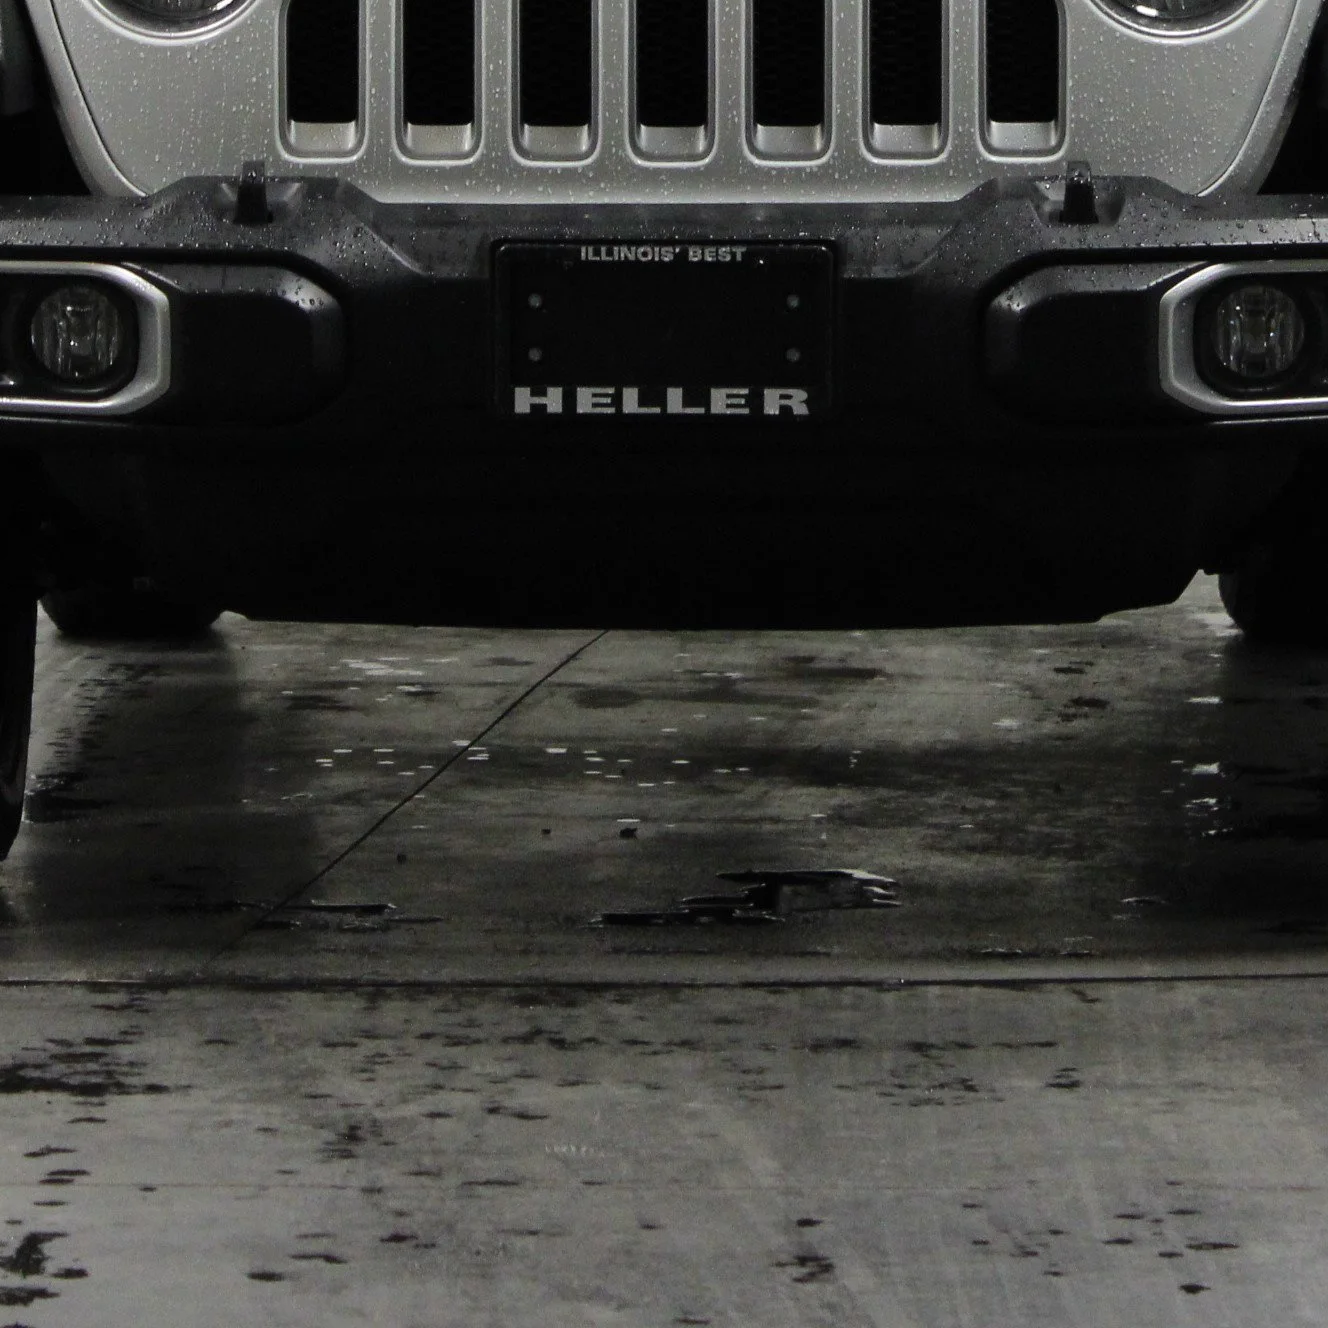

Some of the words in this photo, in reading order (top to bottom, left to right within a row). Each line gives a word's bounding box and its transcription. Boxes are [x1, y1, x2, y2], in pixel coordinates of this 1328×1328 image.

[580, 246, 680, 262] ILLINOIS'
[688, 246, 747, 262] BEST
[514, 387, 810, 415] HELLER
